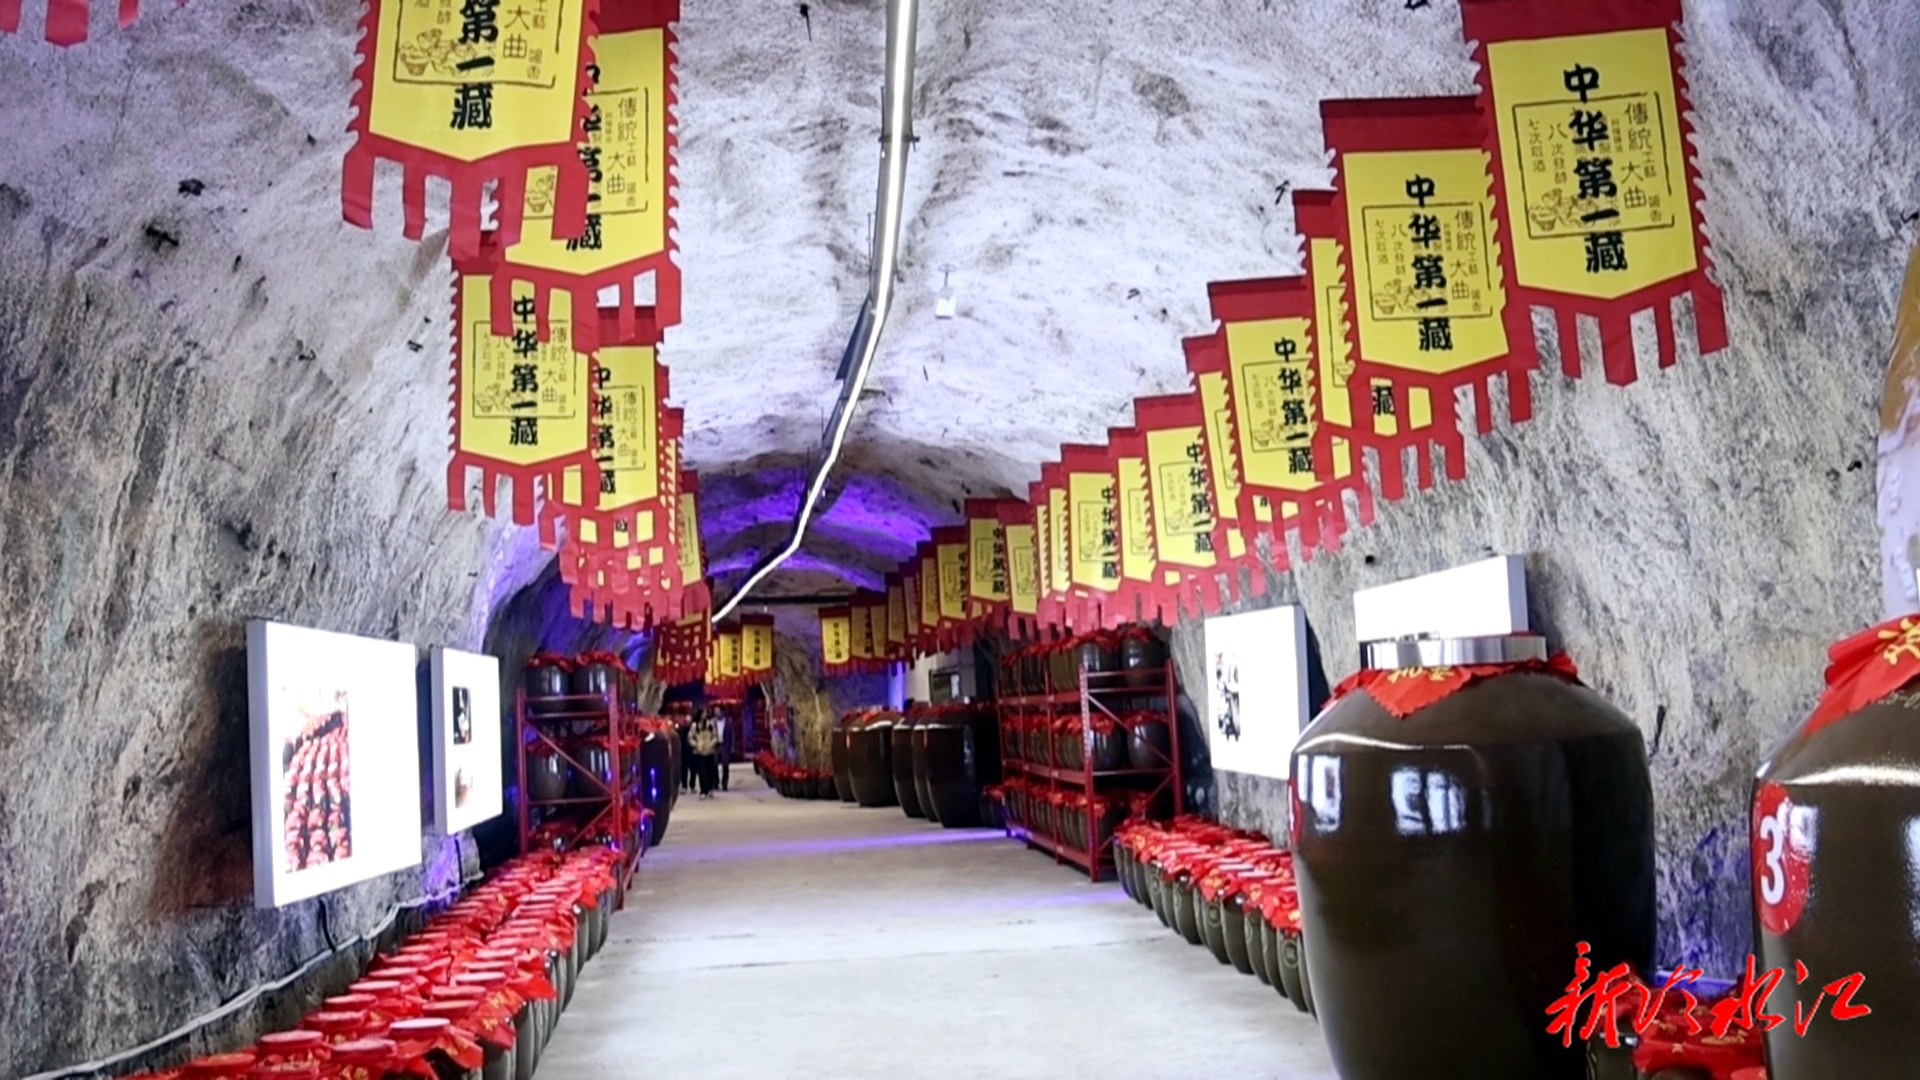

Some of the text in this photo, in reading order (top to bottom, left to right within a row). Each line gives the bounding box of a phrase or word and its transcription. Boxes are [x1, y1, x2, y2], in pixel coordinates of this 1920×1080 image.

[1563, 63, 1627, 273] 中华第一藏
[1620, 161, 1647, 210] 大曲
[1405, 173, 1453, 352] 中华第一藏
[510, 295, 538, 446] 中华第一藏
[1274, 337, 1314, 474] 中华第一藏
[1187, 442, 1213, 553] 中华第一藏
[1760, 816, 1785, 905] 3
